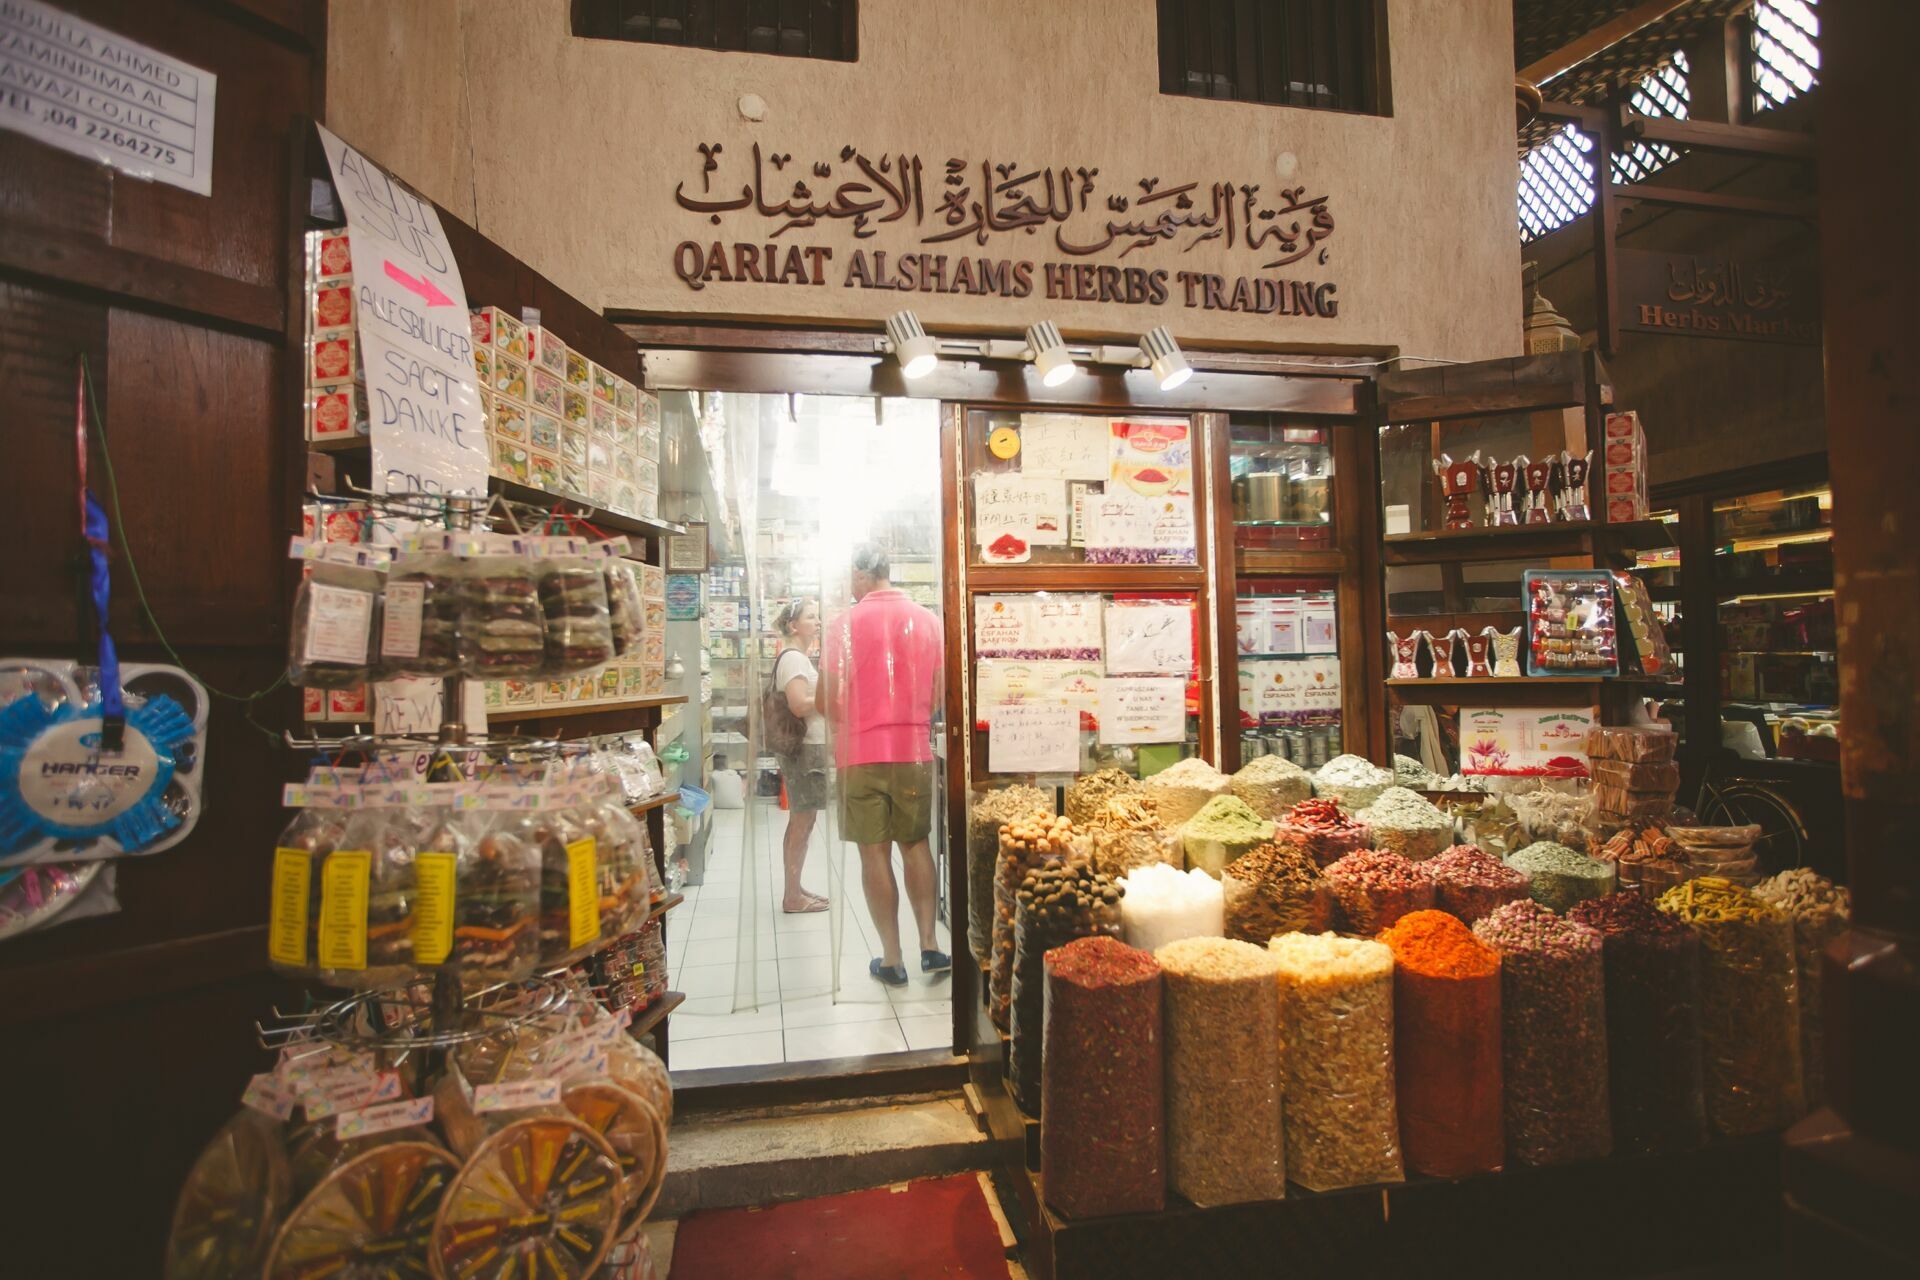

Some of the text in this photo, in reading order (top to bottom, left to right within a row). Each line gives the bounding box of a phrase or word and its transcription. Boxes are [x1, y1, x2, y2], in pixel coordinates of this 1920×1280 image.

[101, 46, 181, 88] AHMED
[88, 96, 161, 135] CO,LLC
[143, 90, 167, 110] AL
[85, 122, 177, 166] 2264275
[920, 157, 1074, 246] للتجارة
[674, 240, 1339, 319] QARIAT ALSHAMS HERBS TRADING
[1639, 304, 1720, 331] Herbs
[384, 350, 460, 406] SAGT
[375, 387, 470, 450] DANKE
[1538, 714, 1561, 724] Jamal
[42, 761, 140, 777] HANGER
